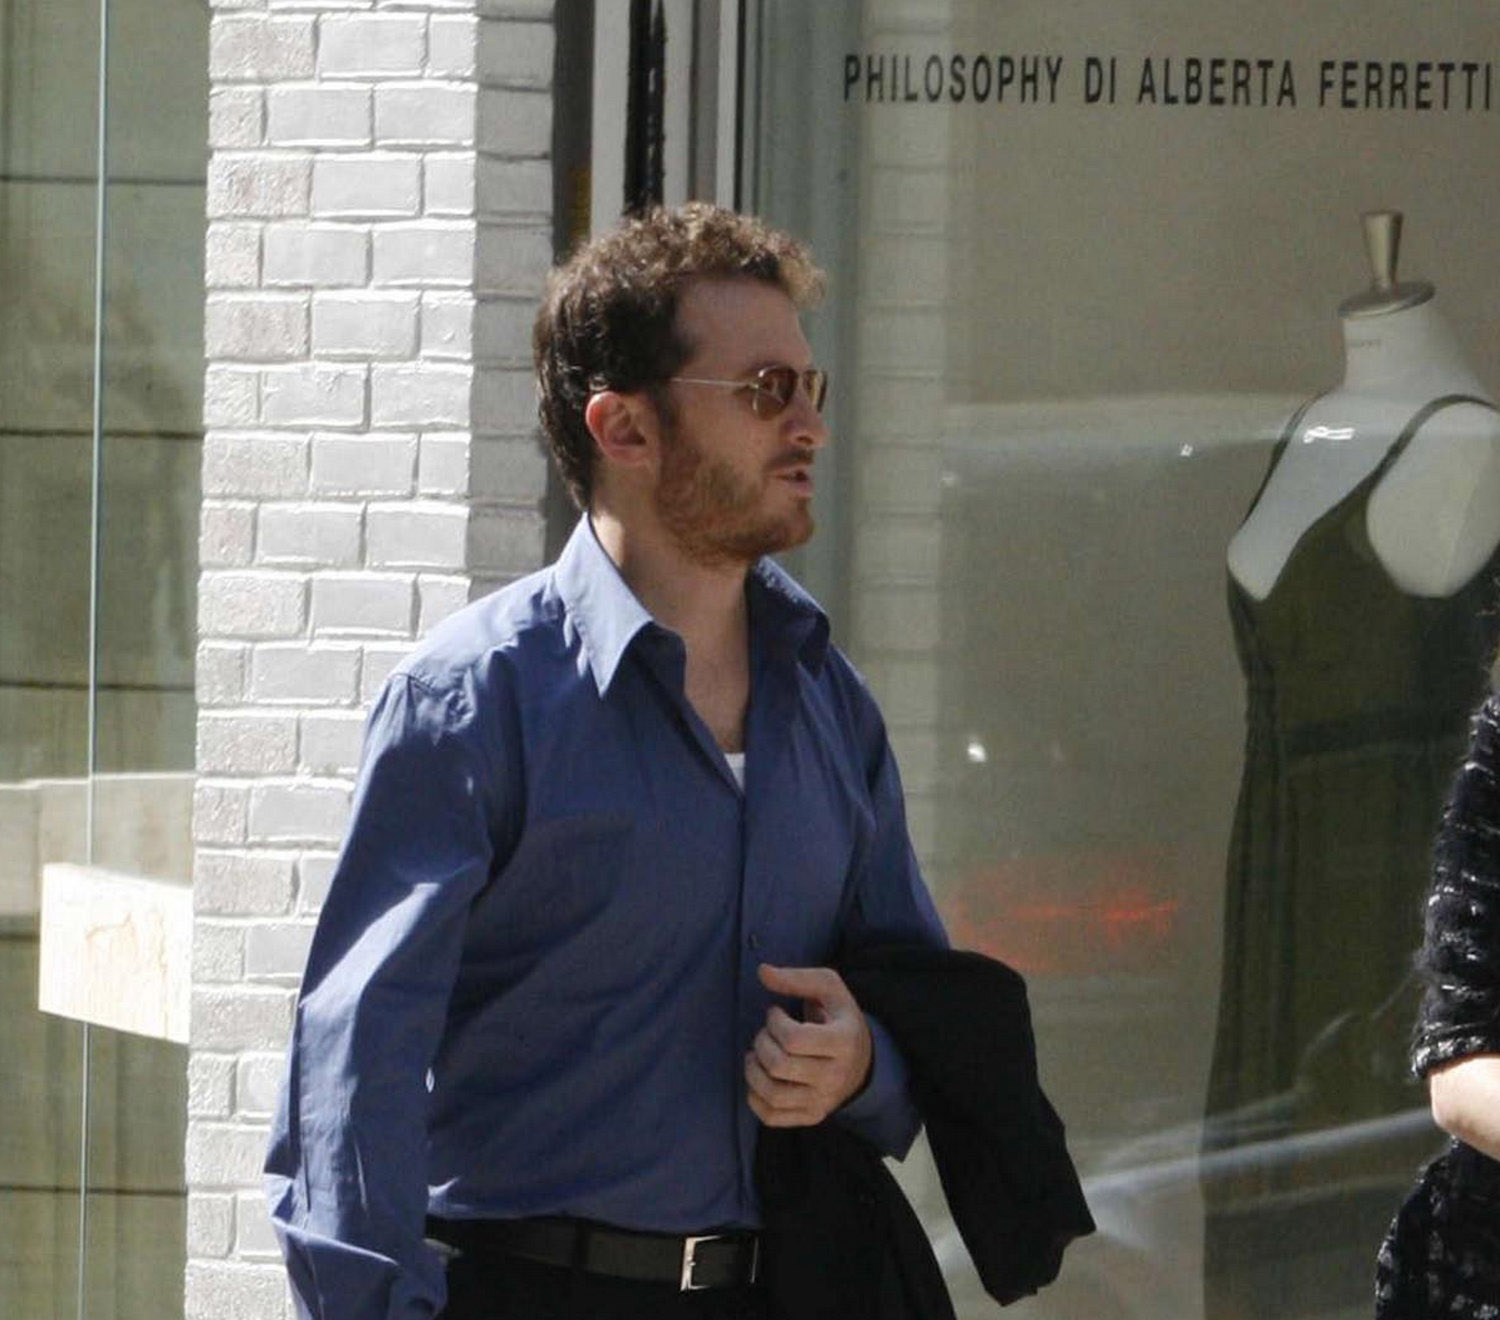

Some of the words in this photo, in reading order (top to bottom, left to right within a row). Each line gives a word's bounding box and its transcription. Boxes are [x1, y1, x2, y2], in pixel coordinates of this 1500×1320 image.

[843, 54, 1063, 103] PHILOSOPHY
[1085, 56, 1116, 104] DI
[1137, 57, 1297, 107] ALBERTA
[1319, 61, 1491, 111] FERRETTI
